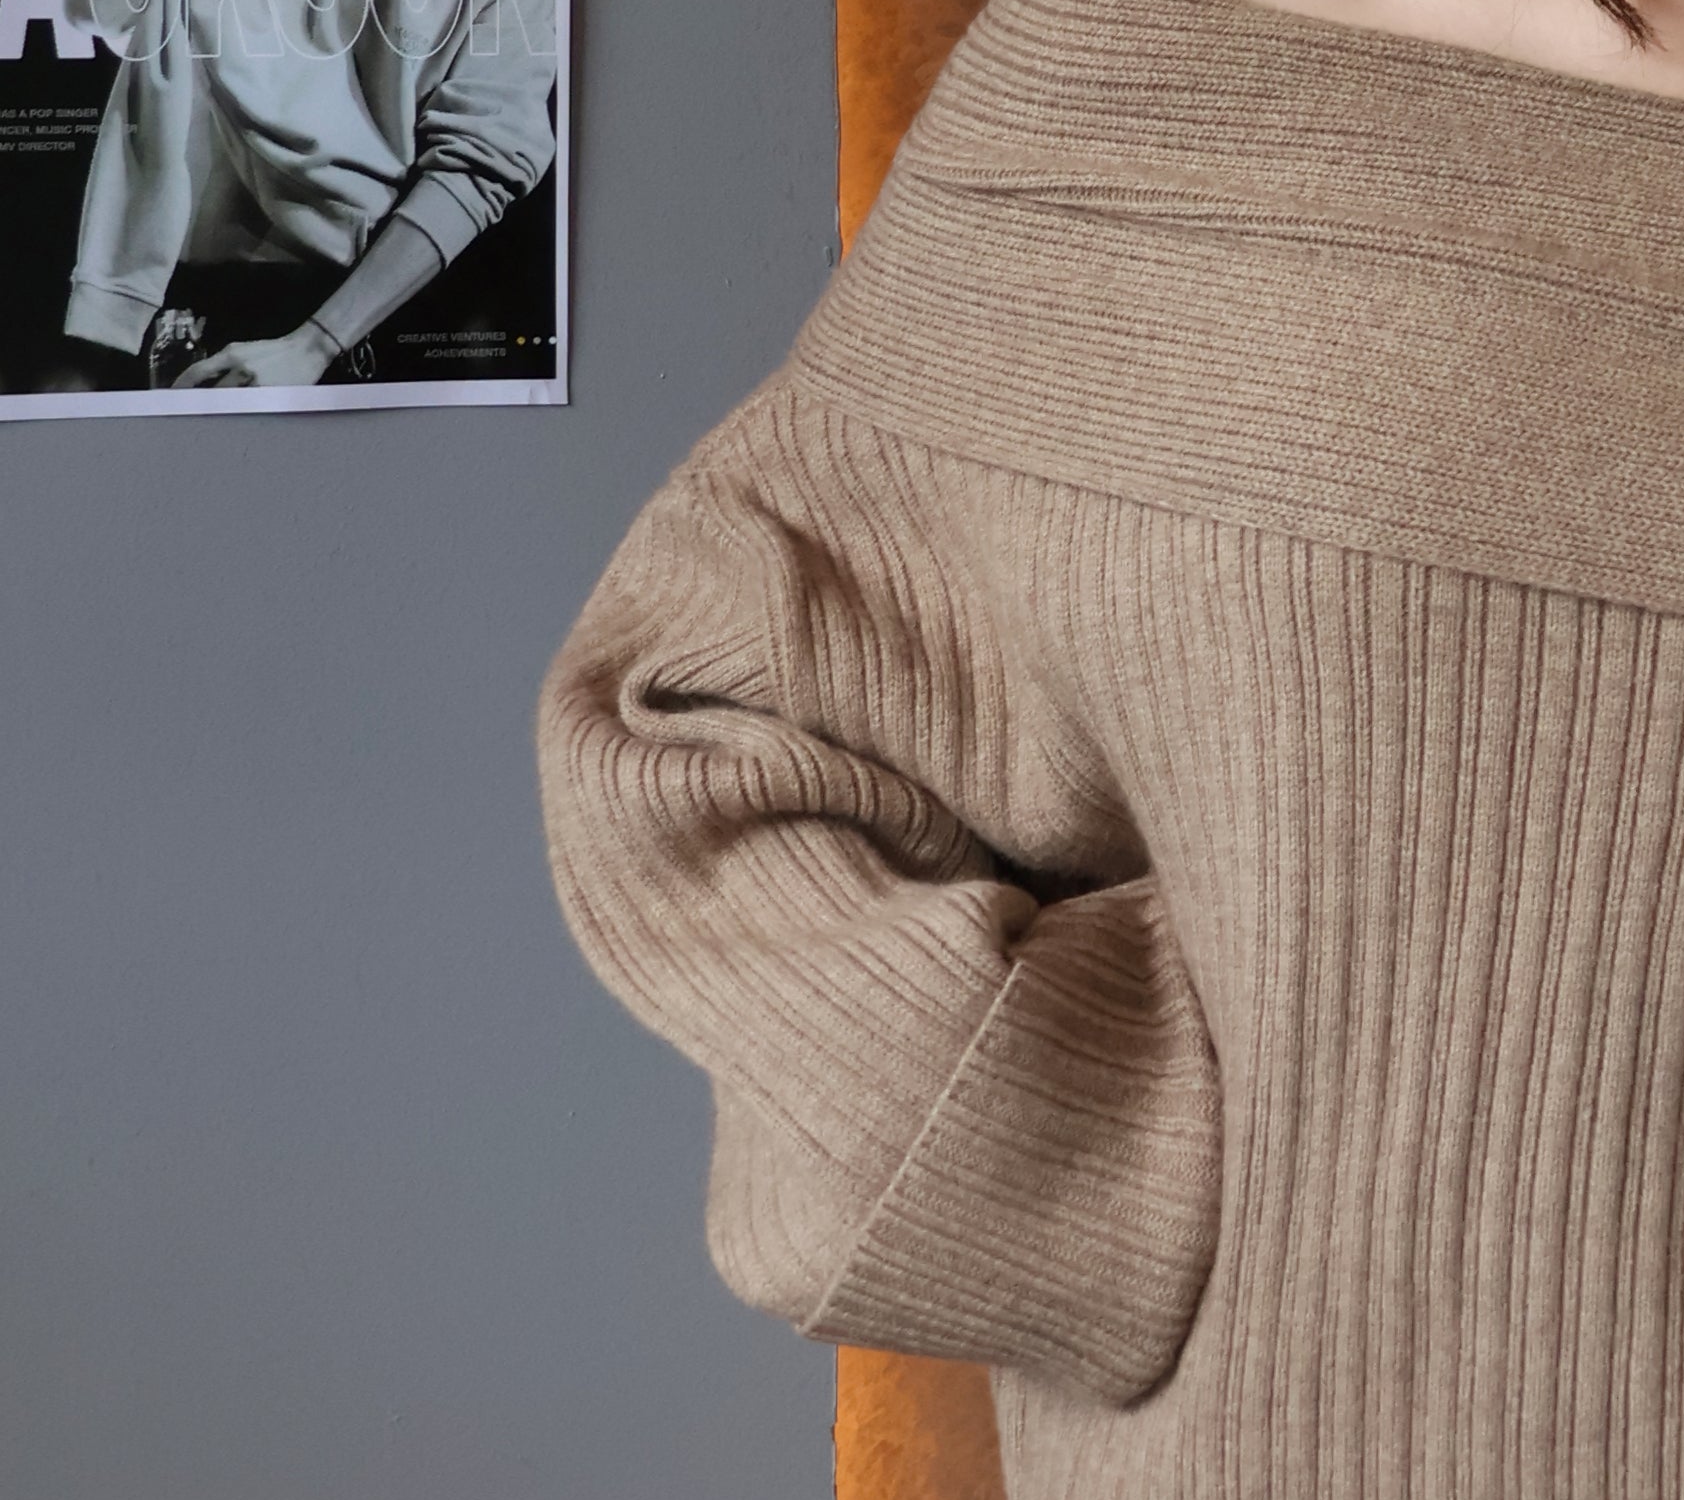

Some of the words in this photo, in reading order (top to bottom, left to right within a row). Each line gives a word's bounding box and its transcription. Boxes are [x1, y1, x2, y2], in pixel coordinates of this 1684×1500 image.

[18, 109, 28, 119] A
[29, 108, 54, 119] POP
[55, 108, 99, 118] SINGER
[35, 125, 72, 135] MUSIC
[18, 141, 76, 152] DIRECTOR
[396, 332, 449, 344] CREATIVE
[450, 331, 506, 342] VENTURES
[423, 347, 506, 358] ACHIEVEMENTS
